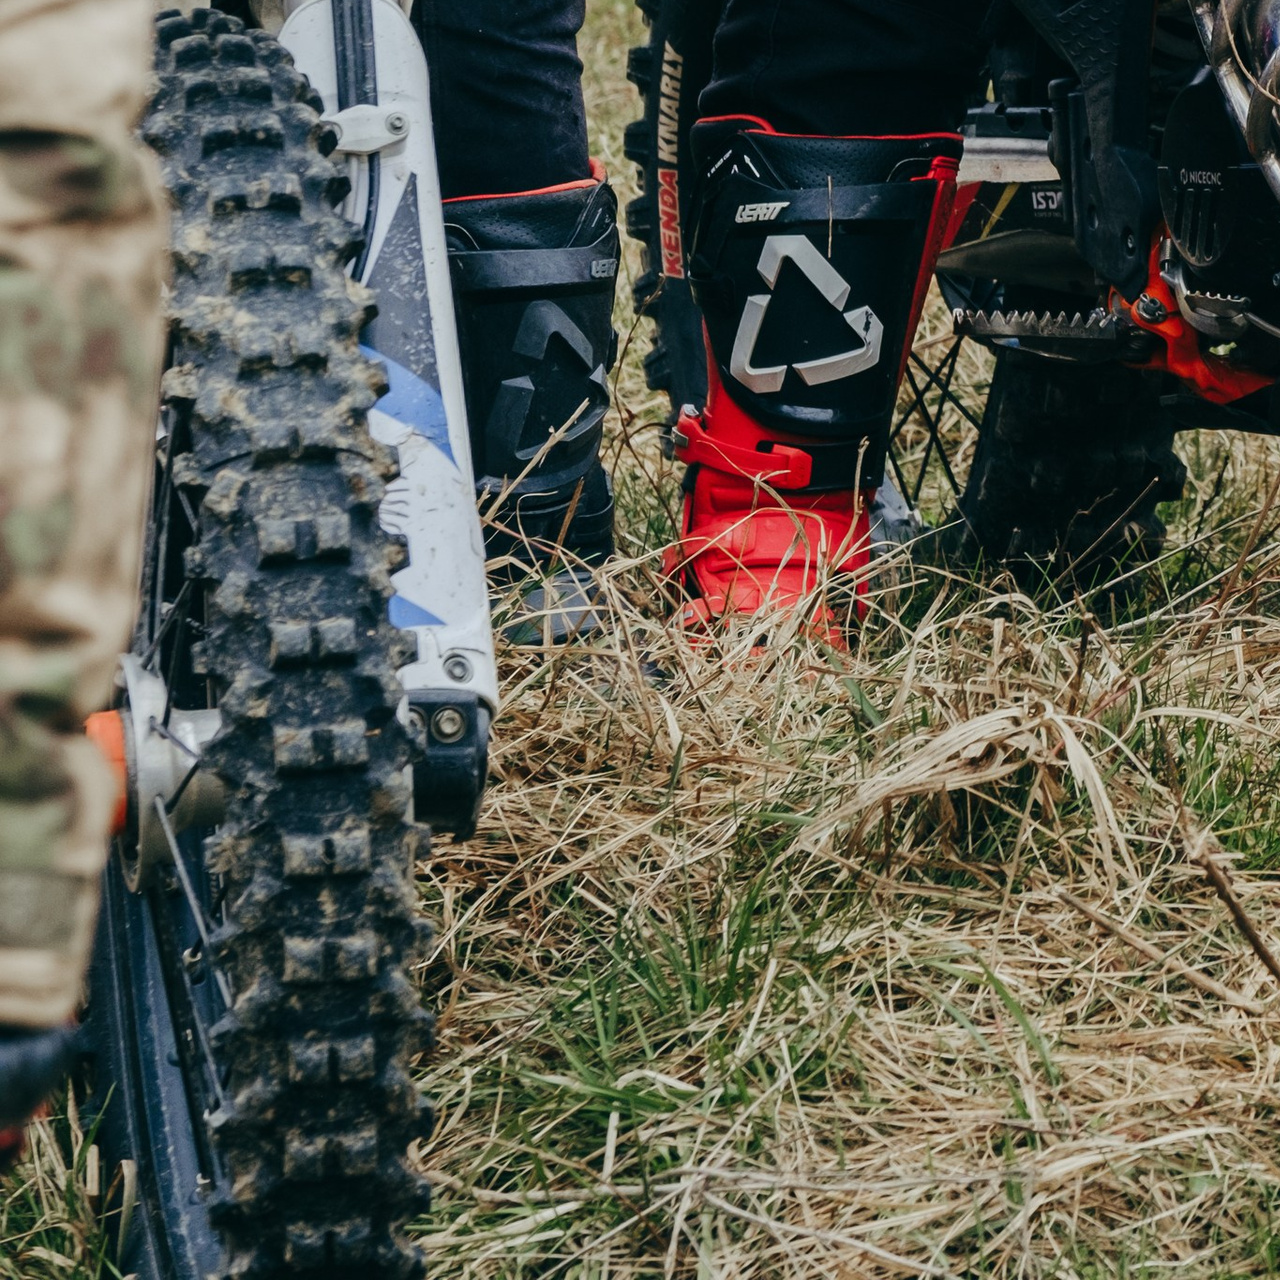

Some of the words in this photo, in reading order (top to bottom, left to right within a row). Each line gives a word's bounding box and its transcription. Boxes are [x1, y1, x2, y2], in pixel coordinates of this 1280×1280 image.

[658, 40, 684, 164] KNARLY
[1189, 170, 1222, 186] NICECNC
[658, 168, 685, 279] KENDA
[735, 201, 791, 224] LEATT
